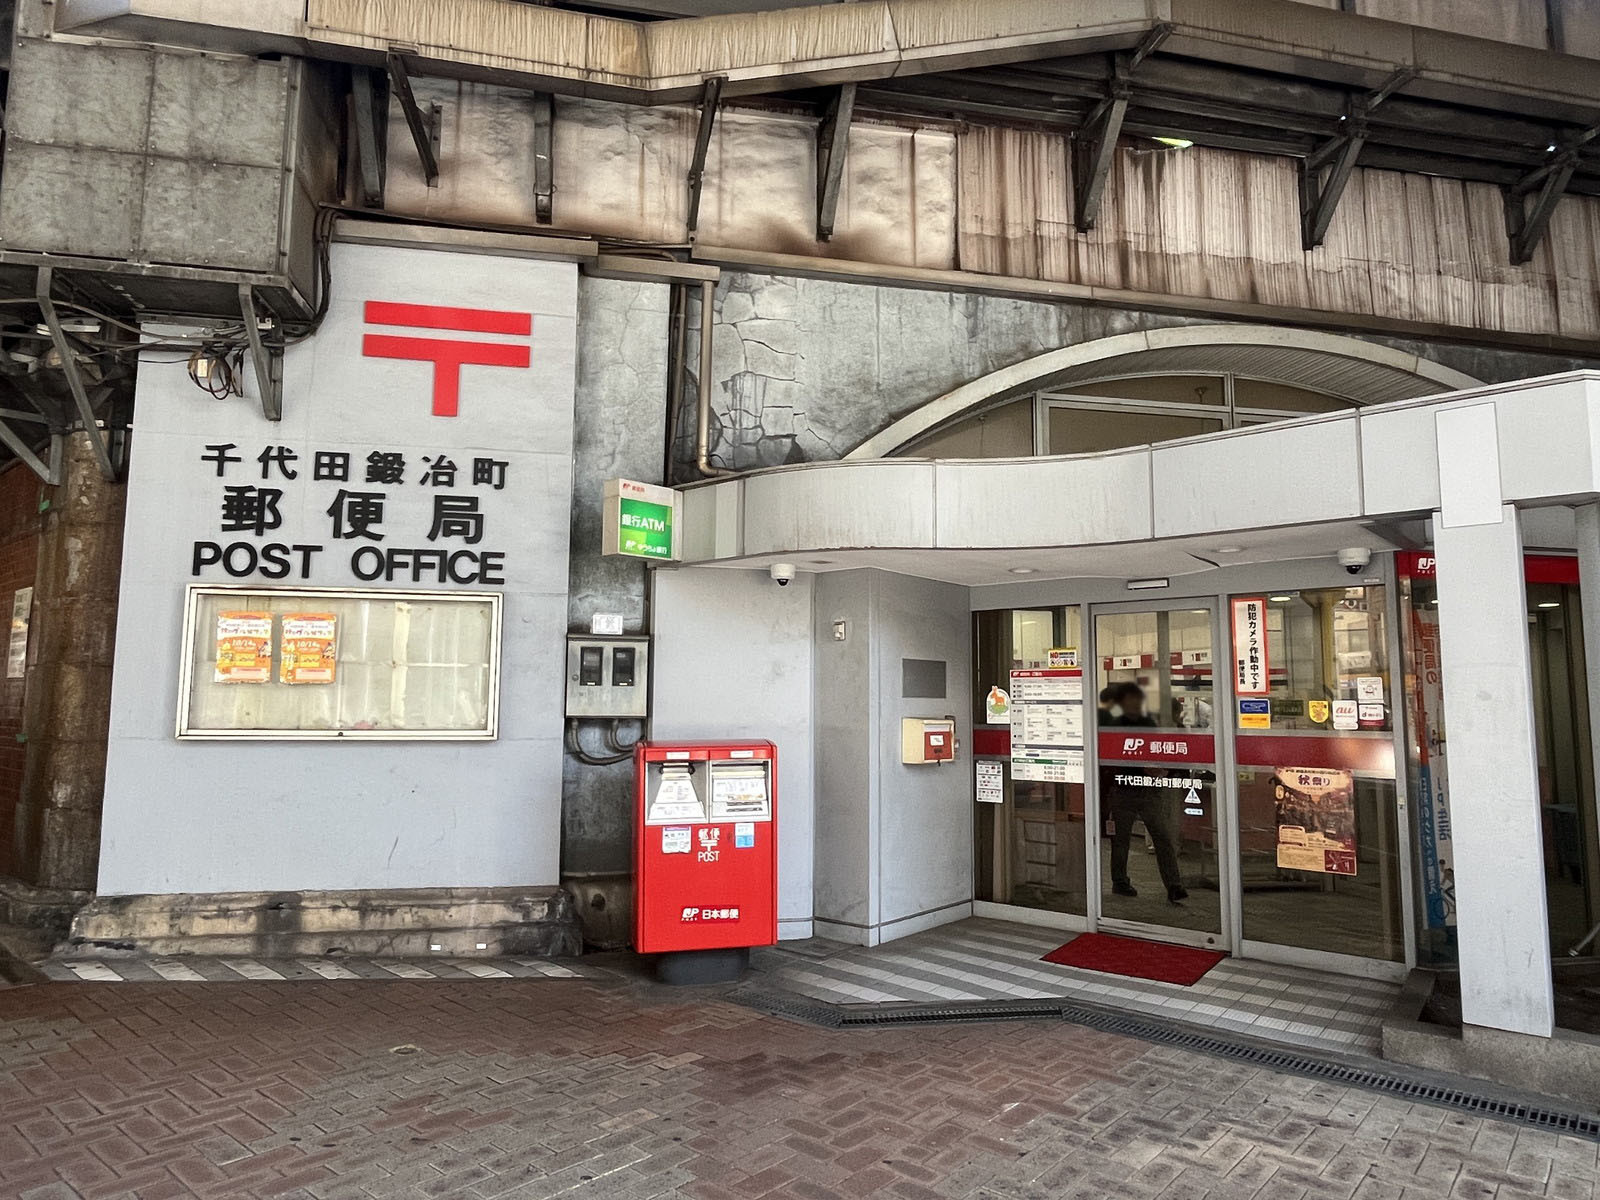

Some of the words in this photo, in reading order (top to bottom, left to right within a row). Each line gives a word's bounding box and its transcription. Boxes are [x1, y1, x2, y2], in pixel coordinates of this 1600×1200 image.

[200, 443, 510, 490] 千代田鍛冶町
[221, 485, 484, 545] 郵便局
[621, 513, 665, 532] 銀行ATM
[192, 541, 323, 579] POST
[351, 546, 506, 585] OFFICE
[1247, 603, 1260, 690] 防犯カメラ作動中です
[1336, 706, 1354, 714] au
[1150, 741, 1188, 755] 郵便局
[1114, 774, 1204, 789] 千代田鍛冶町郵便局
[698, 827, 721, 841] 郵便
[697, 850, 721, 862] POST
[702, 909, 739, 920] 日本郵便
